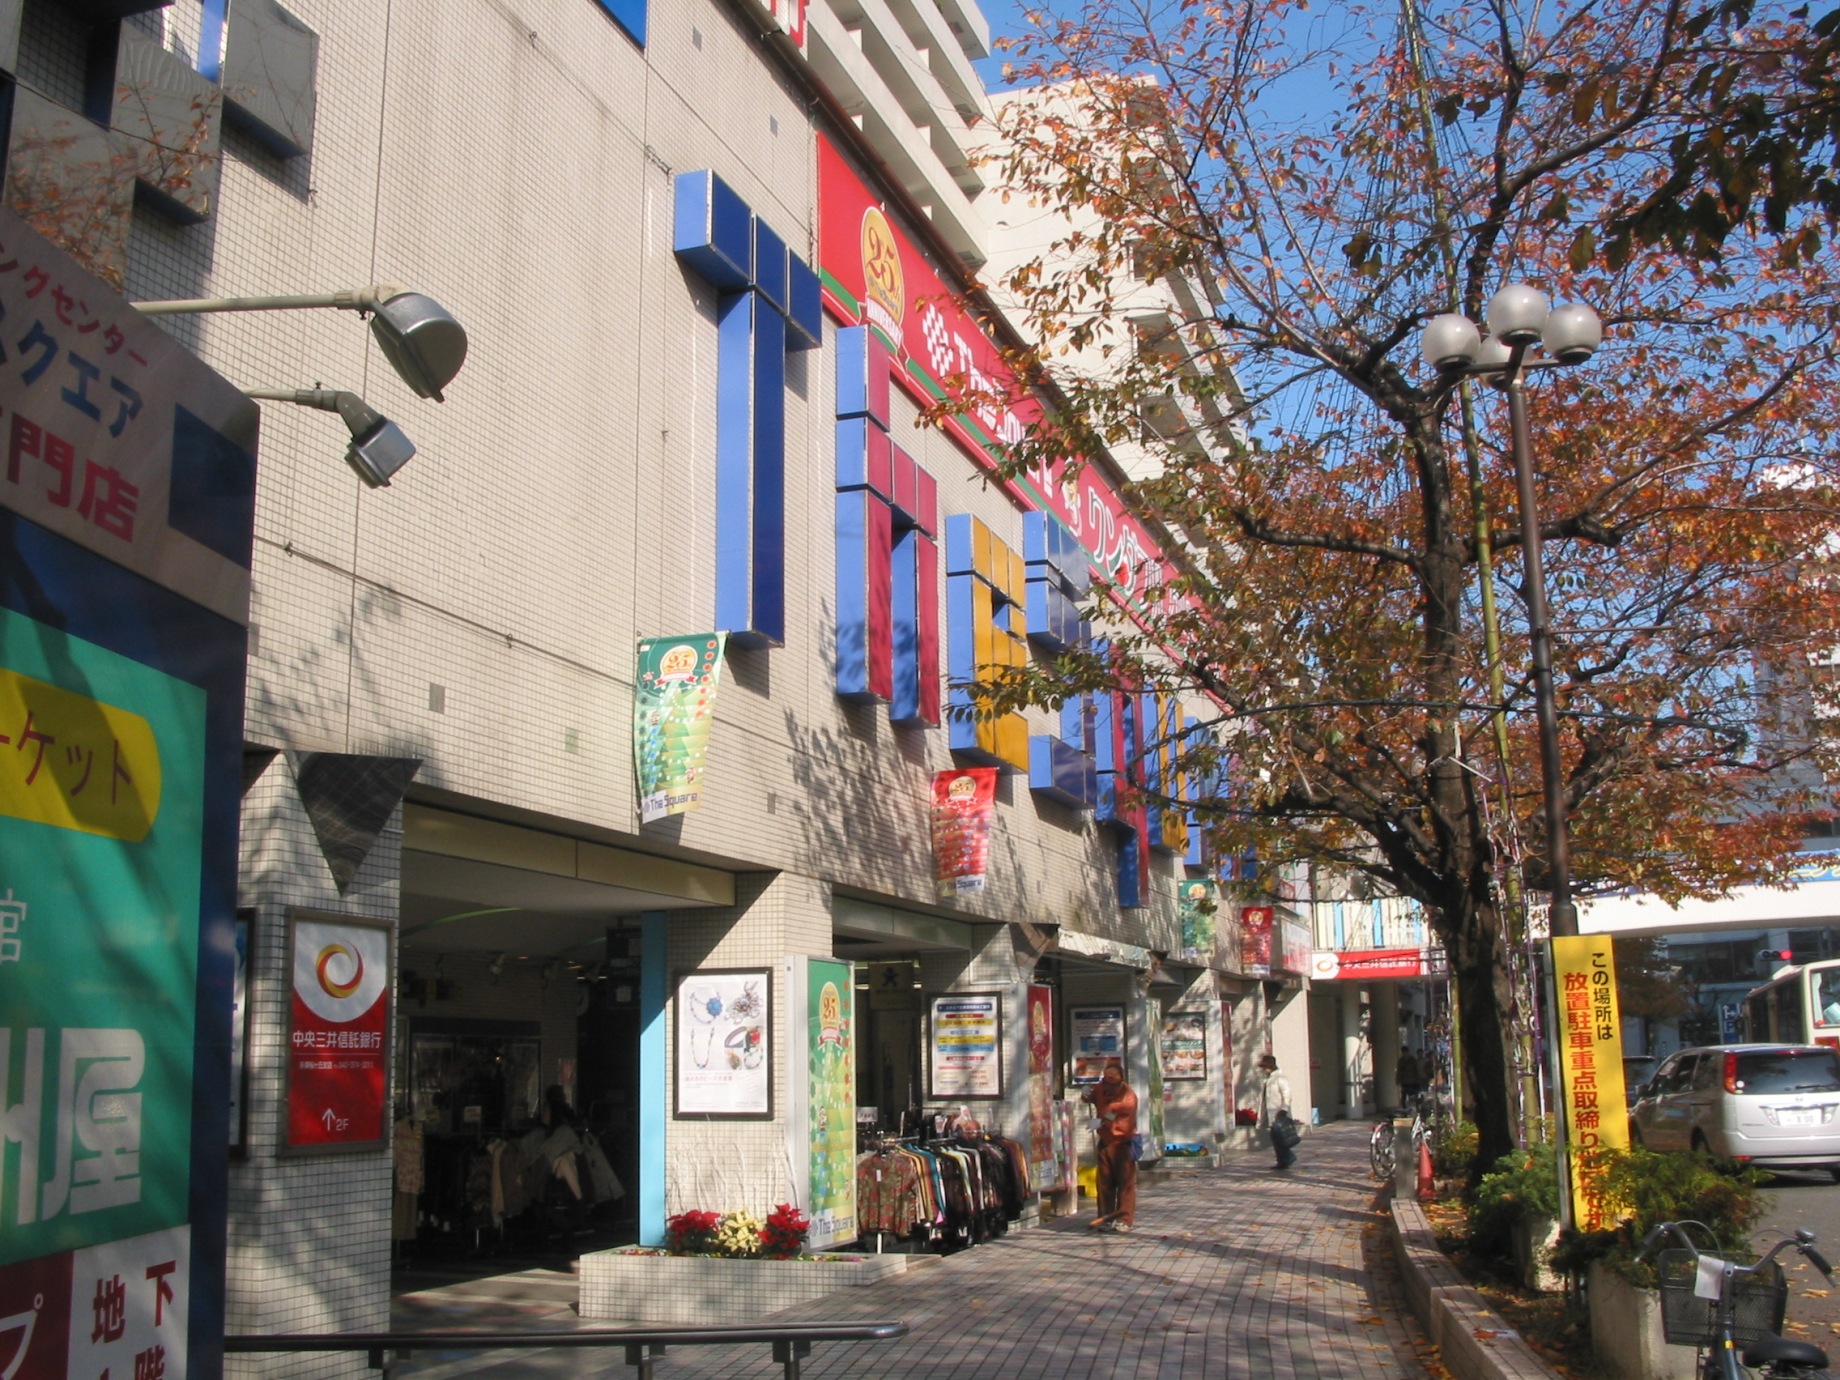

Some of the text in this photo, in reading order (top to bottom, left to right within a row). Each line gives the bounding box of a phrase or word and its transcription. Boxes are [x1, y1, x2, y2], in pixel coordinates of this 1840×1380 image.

[650, 792, 698, 811] The Square
[1591, 952, 1614, 1041] この場所は
[293, 1030, 381, 1049] 中央三井信託銀行
[336, 1118, 350, 1131] 2F
[91, 1259, 177, 1345] 地下
